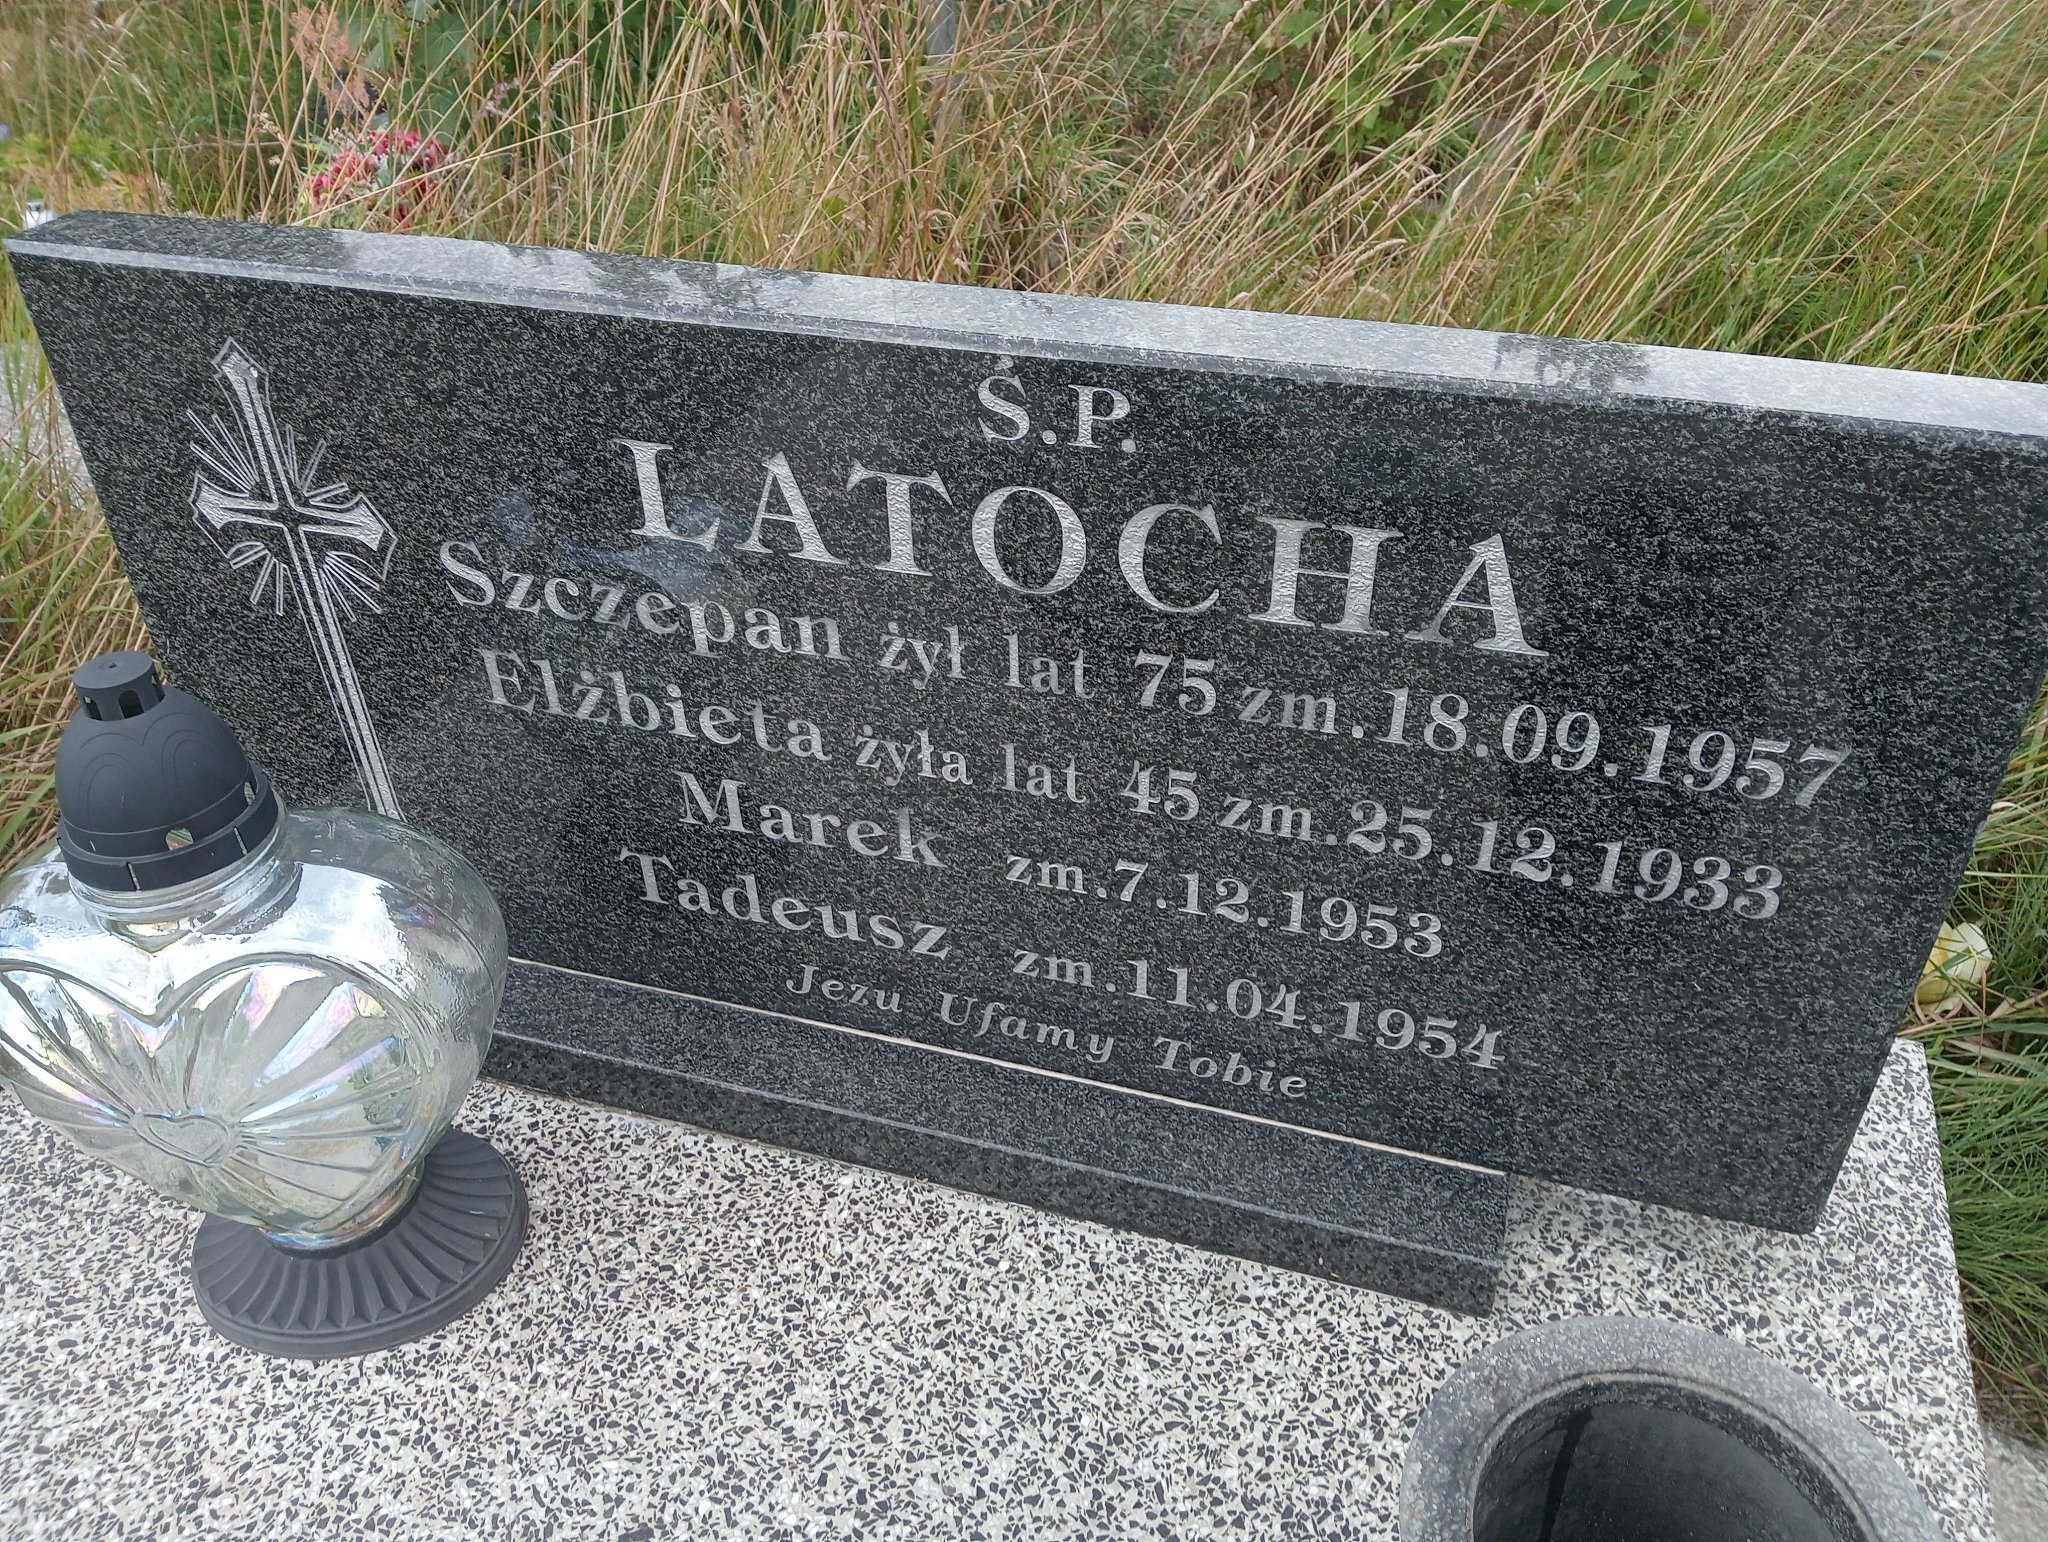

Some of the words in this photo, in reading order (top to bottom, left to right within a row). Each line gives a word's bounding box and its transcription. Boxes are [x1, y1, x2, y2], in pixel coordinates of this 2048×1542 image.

[612, 437, 1550, 656] LATOCHA
[438, 540, 849, 659] Szczepan
[879, 622, 967, 689] żył
[1003, 634, 1095, 699] lat
[1134, 650, 1216, 715] 75
[478, 647, 831, 760] Elżbieta
[856, 724, 972, 786] żyła
[1001, 743, 1086, 803] lat
[1119, 760, 1199, 821] 45
[674, 771, 948, 868] Marek
[619, 847, 951, 960] Tadeusz
[786, 964, 902, 1013] Jezu
[939, 991, 1115, 1063] Ufamy
[1154, 1037, 1307, 1098] Tobie
